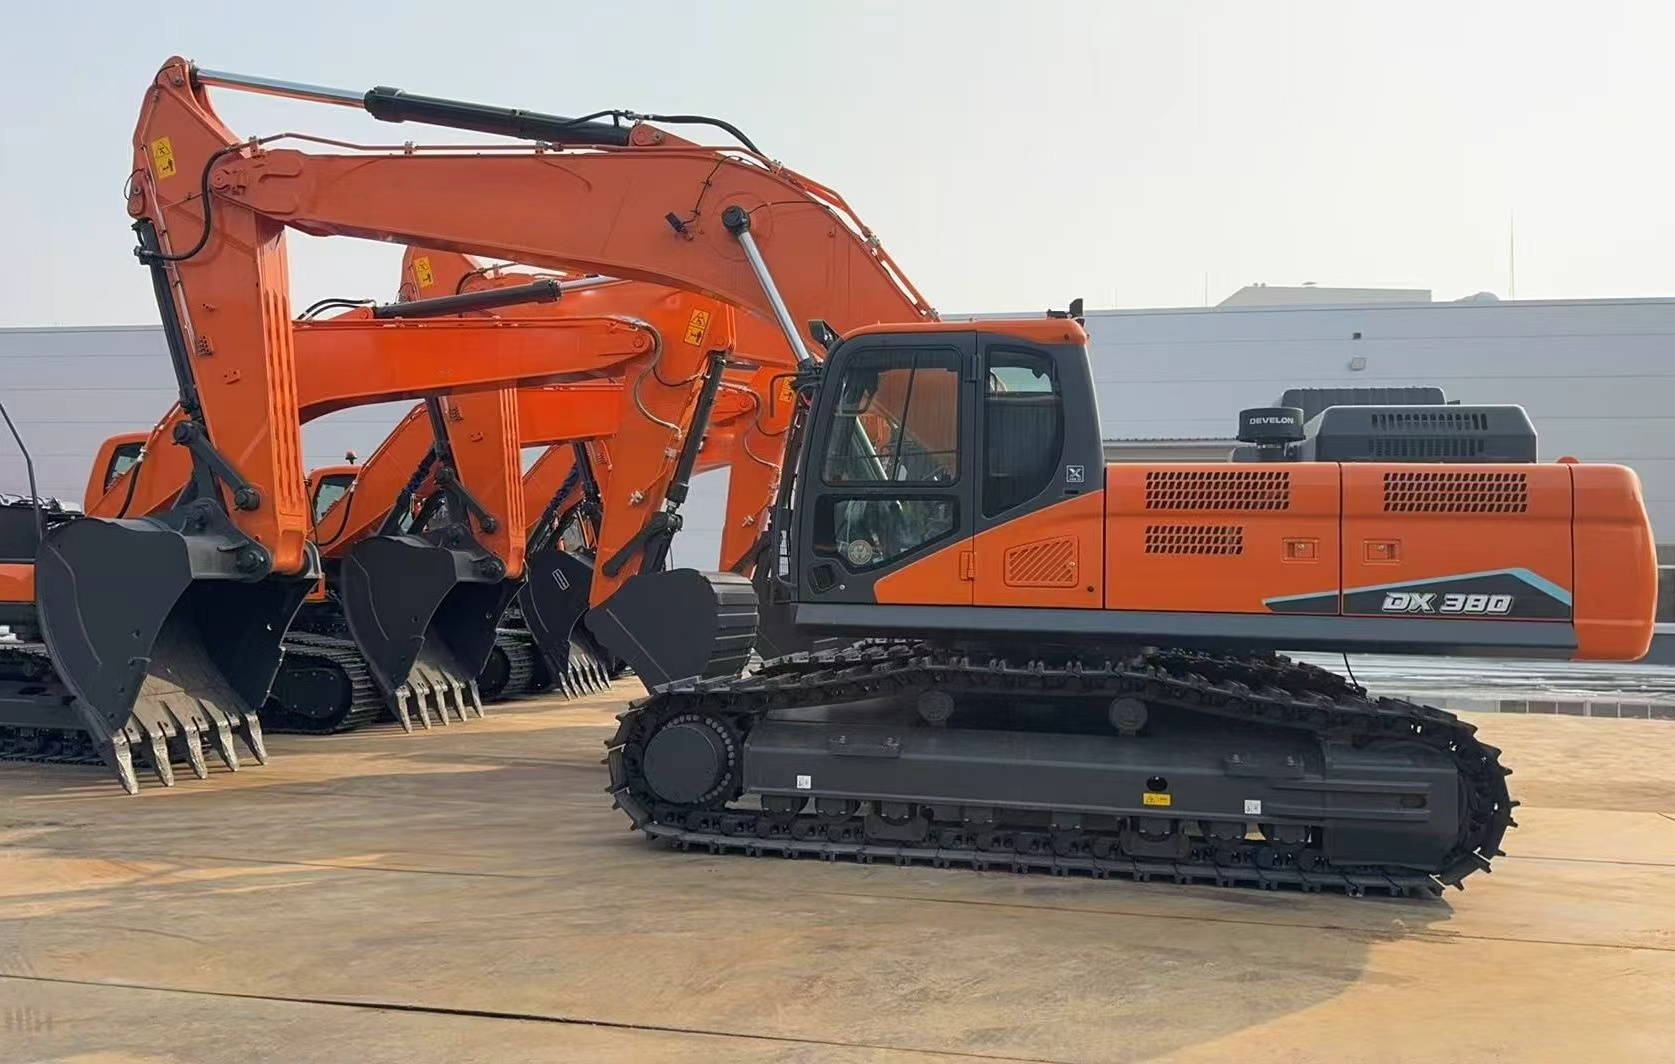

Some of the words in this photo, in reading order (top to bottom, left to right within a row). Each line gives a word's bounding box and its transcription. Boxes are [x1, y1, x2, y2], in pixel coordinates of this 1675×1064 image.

[1249, 416, 1294, 425] DEVELON
[1382, 592, 1437, 613] DX
[1440, 593, 1513, 615] 380
